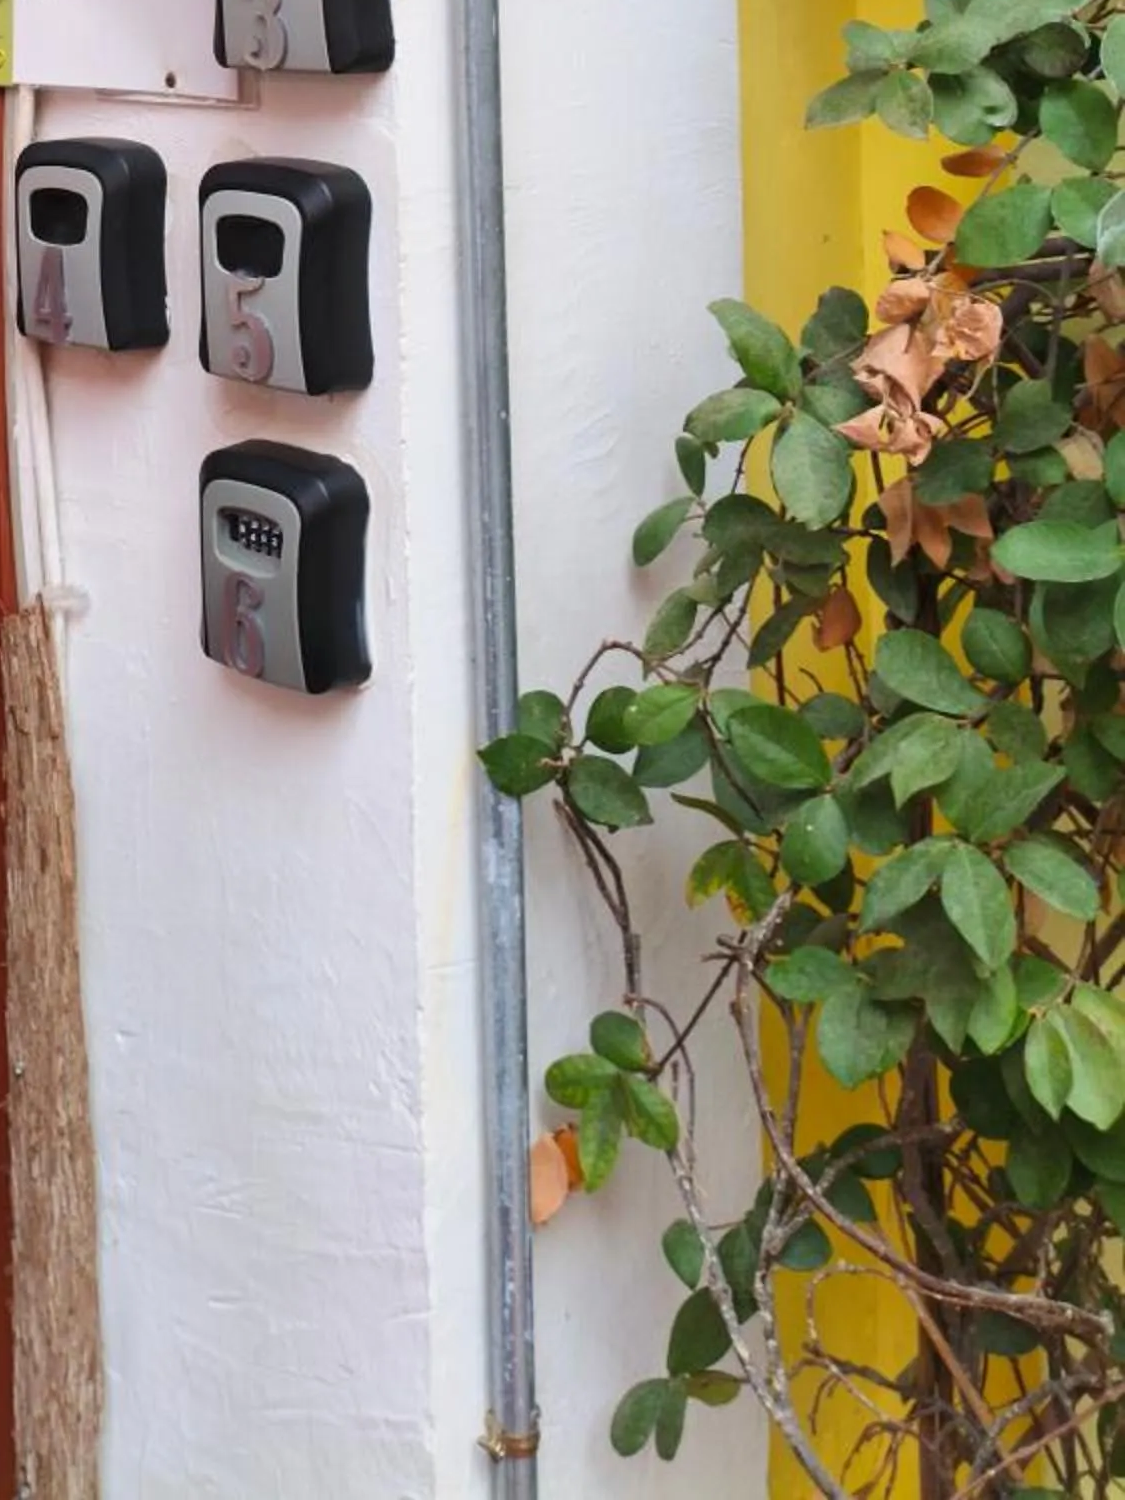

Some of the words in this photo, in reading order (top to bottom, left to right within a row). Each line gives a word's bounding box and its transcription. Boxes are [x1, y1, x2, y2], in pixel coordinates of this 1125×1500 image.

[32, 247, 73, 343] 4
[230, 270, 274, 382] 5
[221, 570, 265, 678] 6
